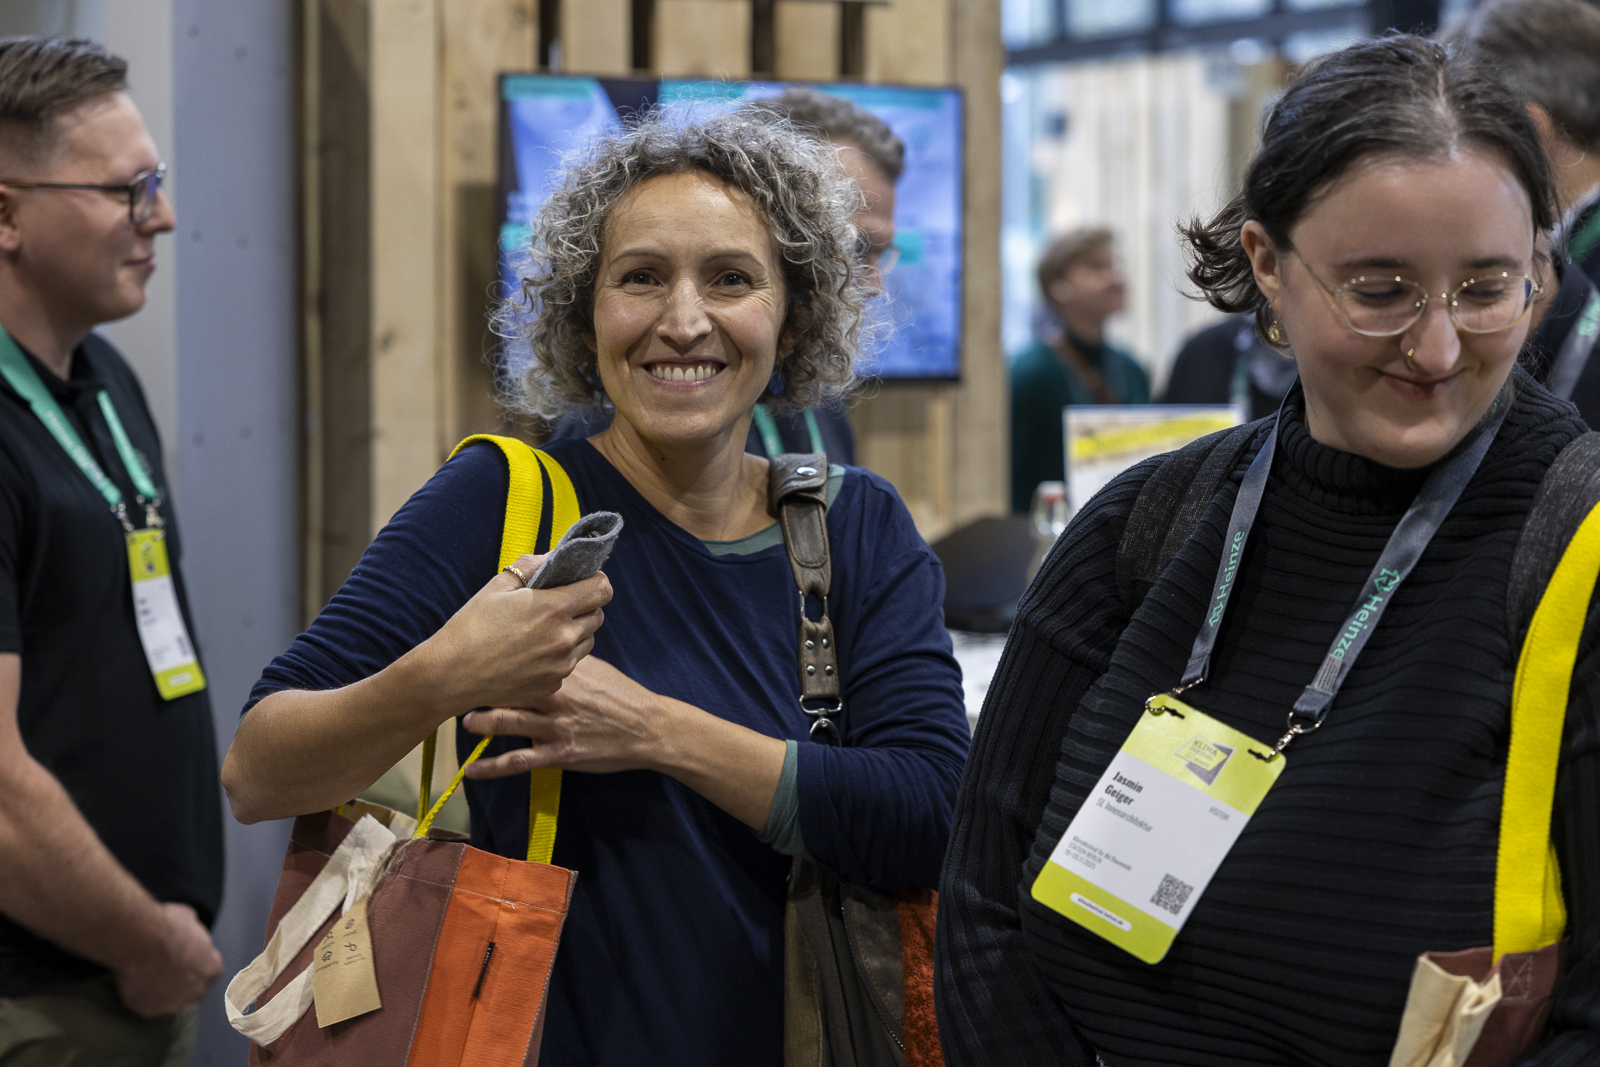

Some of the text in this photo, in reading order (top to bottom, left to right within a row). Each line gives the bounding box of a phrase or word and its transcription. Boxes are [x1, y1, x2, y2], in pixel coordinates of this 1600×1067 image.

[1217, 530, 1245, 600] Heinze
[1332, 594, 1384, 660] Heinze
[1193, 740, 1218, 756] KLIMA
[1112, 771, 1145, 793] Jasmin
[1102, 783, 1135, 807] Geiger
